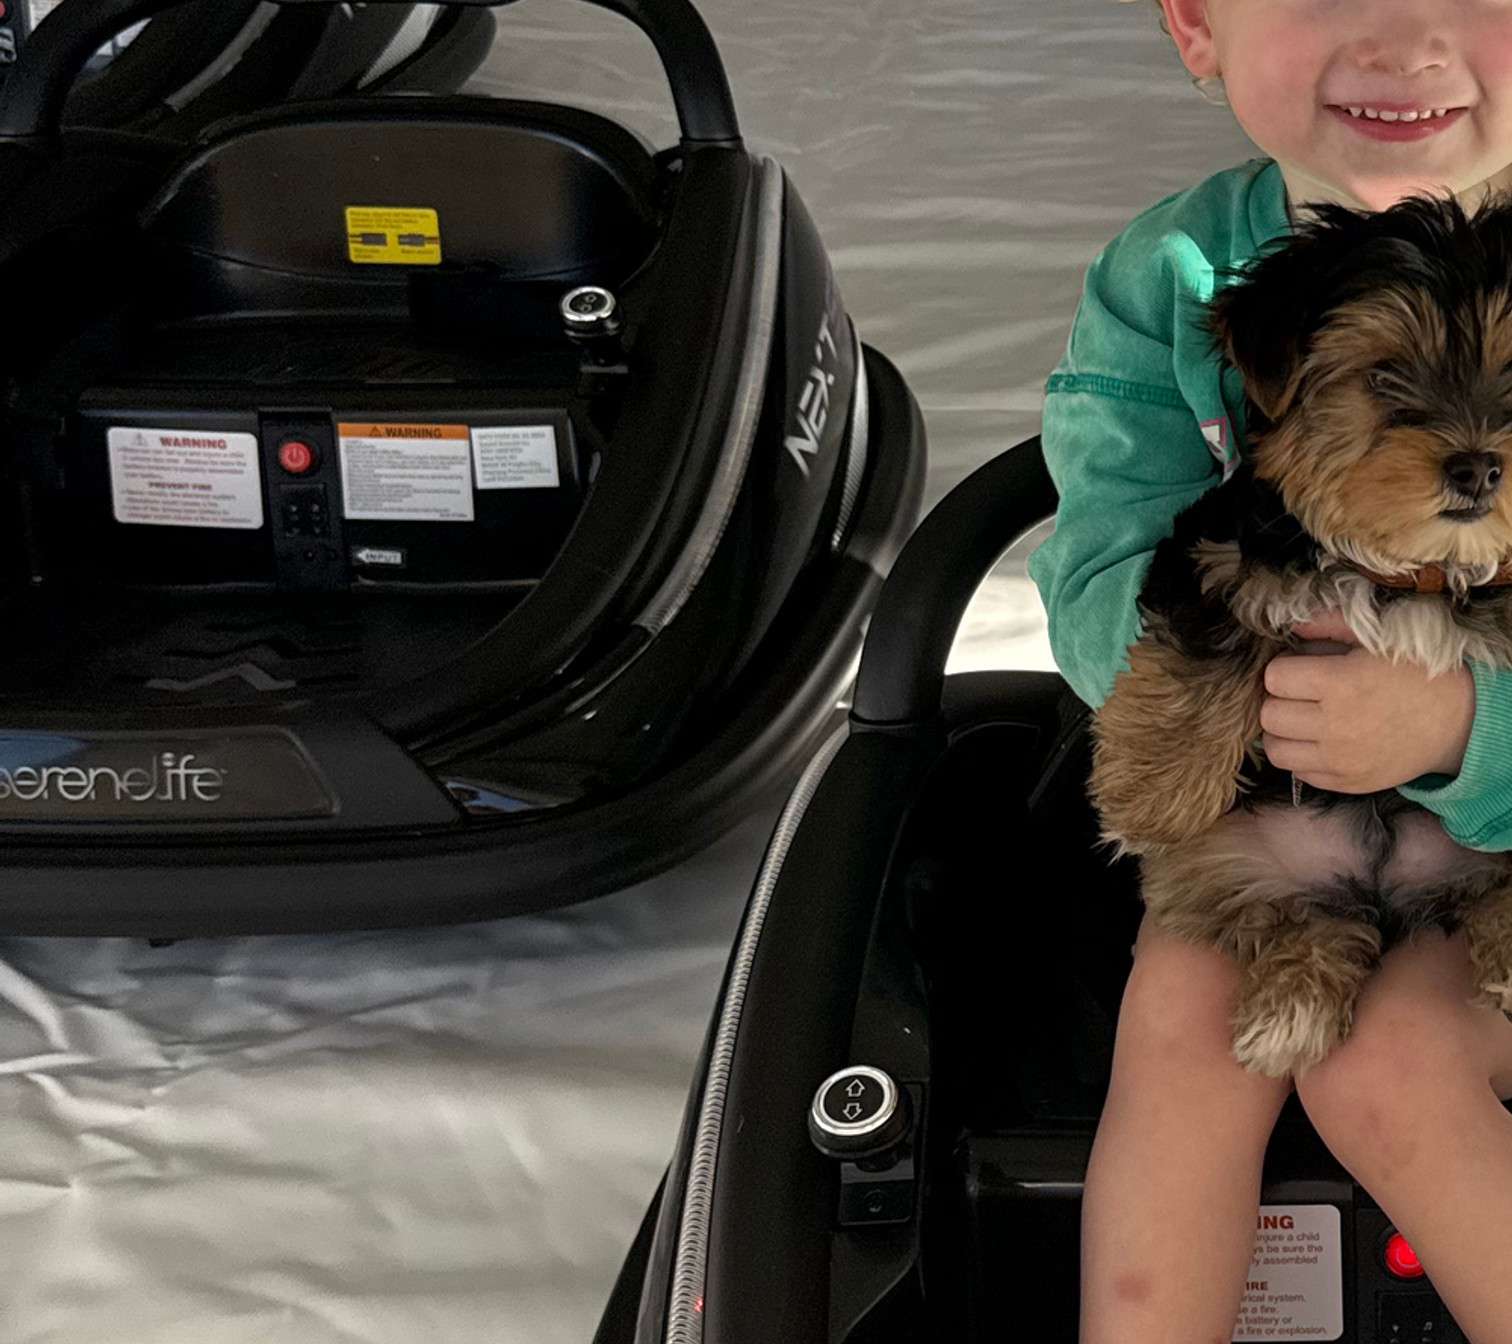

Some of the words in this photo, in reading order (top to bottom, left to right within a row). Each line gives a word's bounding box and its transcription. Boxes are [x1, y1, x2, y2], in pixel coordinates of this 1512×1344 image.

[385, 427, 442, 438] WARNING
[160, 436, 228, 449] WARNING
[1296, 1232, 1320, 1241] child
[1266, 1244, 1279, 1253] be
[1307, 1244, 1323, 1253] the
[1263, 1255, 1318, 1264] assembled
[1245, 1281, 1269, 1291] IRE
[1245, 1316, 1279, 1326] battery
[1247, 1326, 1263, 1335] fire
